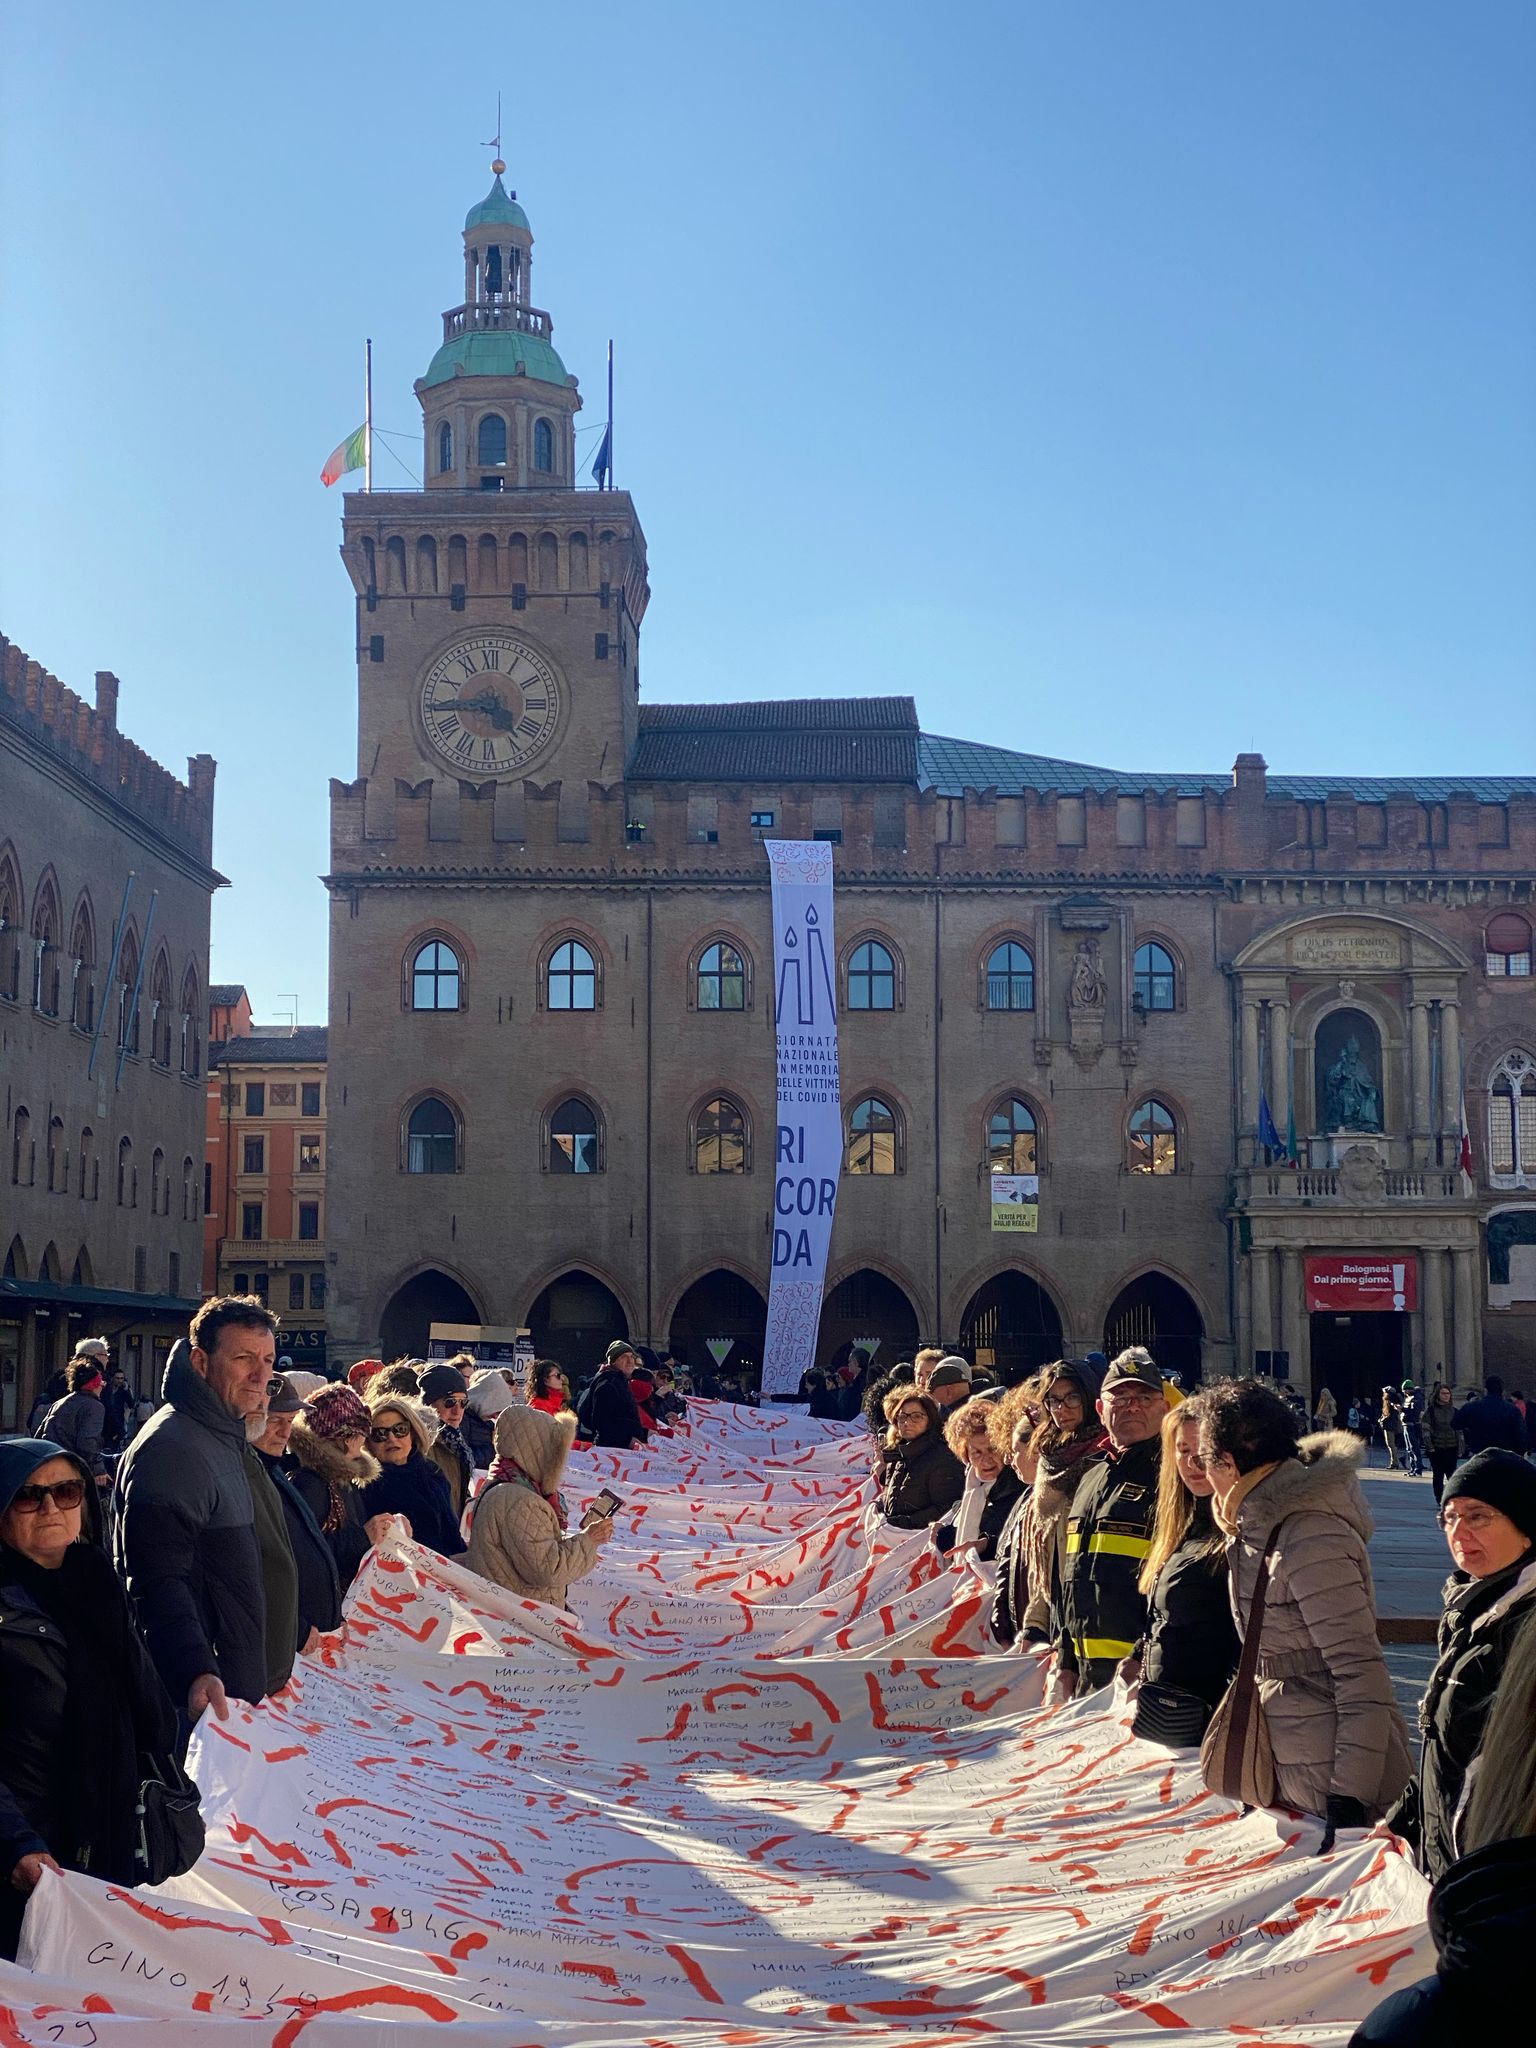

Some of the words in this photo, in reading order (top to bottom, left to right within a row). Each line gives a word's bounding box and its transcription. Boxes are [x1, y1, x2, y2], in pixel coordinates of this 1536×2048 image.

[458, 655, 477, 678] XI
[482, 650, 499, 670] XII
[440, 674, 461, 691] X
[776, 1035, 838, 1046] GIORNATA
[776, 1049, 839, 1061] NAZIONALE
[790, 1063, 839, 1075] MEMORIA
[777, 1077, 802, 1088] DELLE
[805, 1078, 839, 1089] VITTIME
[777, 1091, 794, 1102] DEL
[798, 1091, 827, 1103] COVID
[831, 1092, 839, 1103] 19
[776, 1125, 804, 1163] RI
[775, 1176, 836, 1216] COR
[772, 1228, 812, 1267] DA
[1342, 1265, 1392, 1275] Bolognesi.
[1314, 1275, 1329, 1284] Dal
[1330, 1275, 1357, 1286] primo
[1358, 1275, 1392, 1286] giorno.
[280, 1332, 327, 1346] PAS
[268, 1878, 361, 1919] ROSA
[382, 1906, 470, 1941] 1946
[87, 1942, 188, 1988] GINO
[497, 1955, 545, 1975] MARIA
